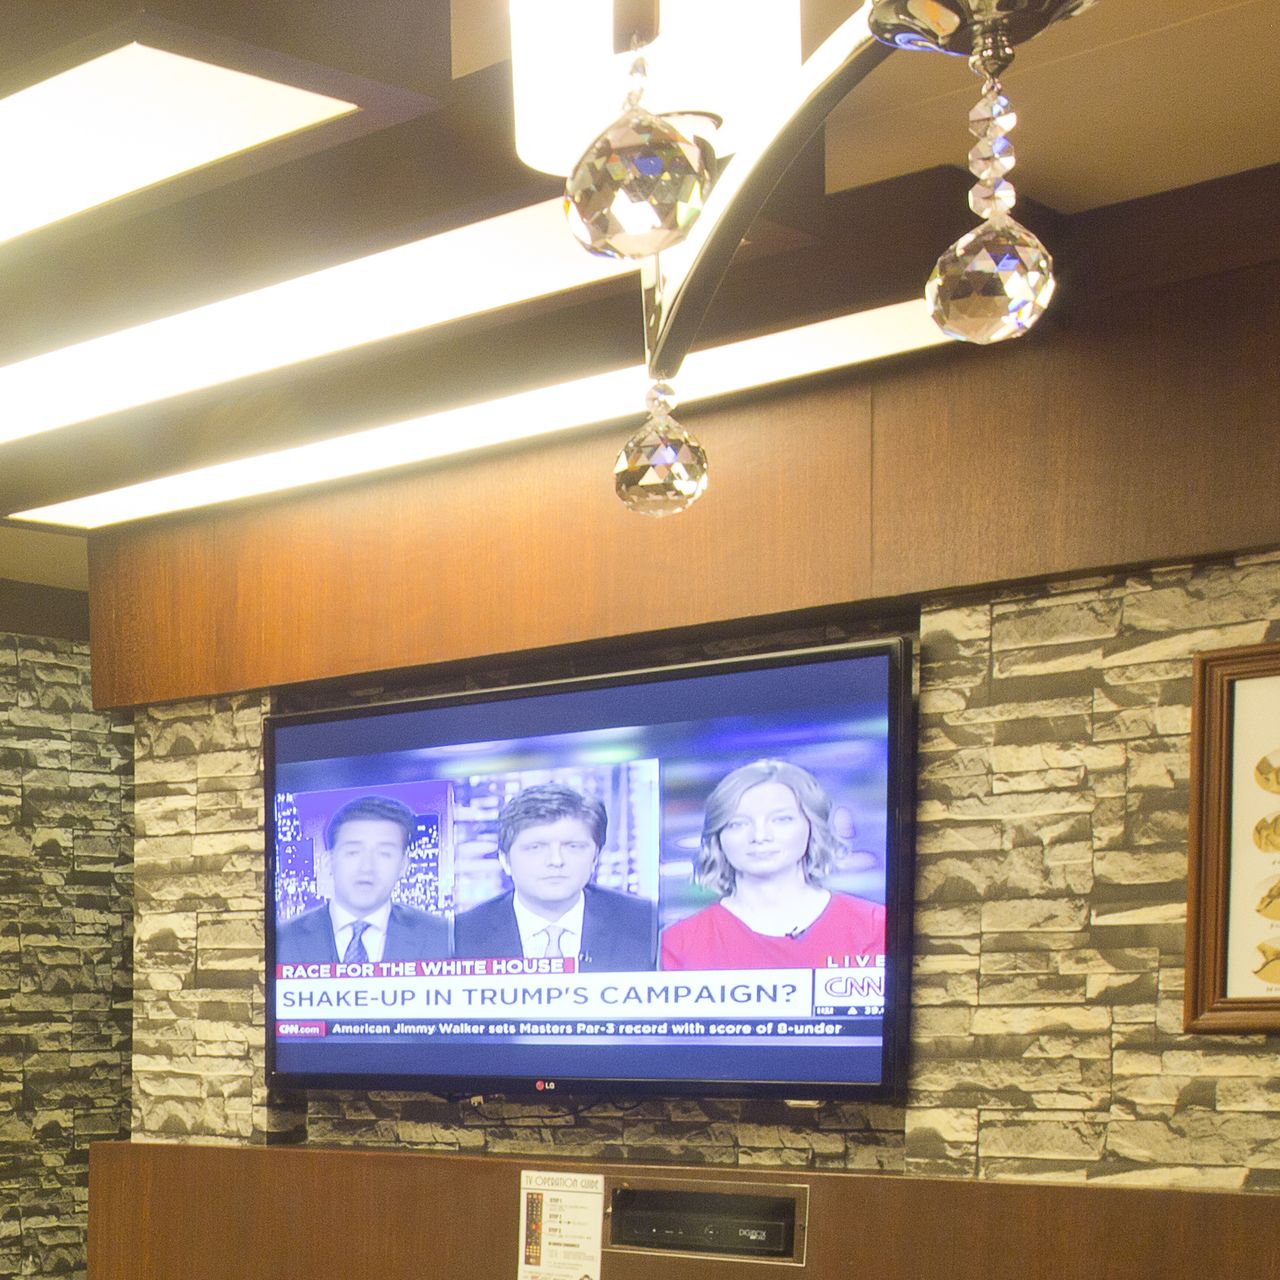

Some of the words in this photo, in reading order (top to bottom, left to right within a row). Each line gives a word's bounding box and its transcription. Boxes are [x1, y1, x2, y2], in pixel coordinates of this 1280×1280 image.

[282, 964, 331, 978] RACE
[335, 963, 375, 977] FOR
[379, 962, 416, 976] THE
[420, 960, 487, 976] WHITE
[492, 957, 564, 974] HOUSE
[827, 954, 885, 968] LIVE
[825, 976, 885, 997] CNN
[283, 989, 416, 1007] SHAKE-UP
[426, 988, 452, 1006] IN
[462, 986, 589, 1006] TRUMP'S
[600, 984, 797, 1004] CAMPAIGN?
[332, 1023, 390, 1034] American
[393, 1023, 435, 1036] Jimmy
[438, 1023, 485, 1034] Walker
[488, 1023, 516, 1034] sets
[519, 1023, 573, 1034] Masters
[576, 1023, 615, 1034] Par-3
[619, 1023, 667, 1034] record
[671, 1023, 705, 1034] with
[709, 1023, 752, 1034] score
[756, 1023, 774, 1034] of
[777, 1023, 843, 1034] 8-under
[526, 1175, 533, 1185] TV
[535, 1175, 578, 1189] OPERATION
